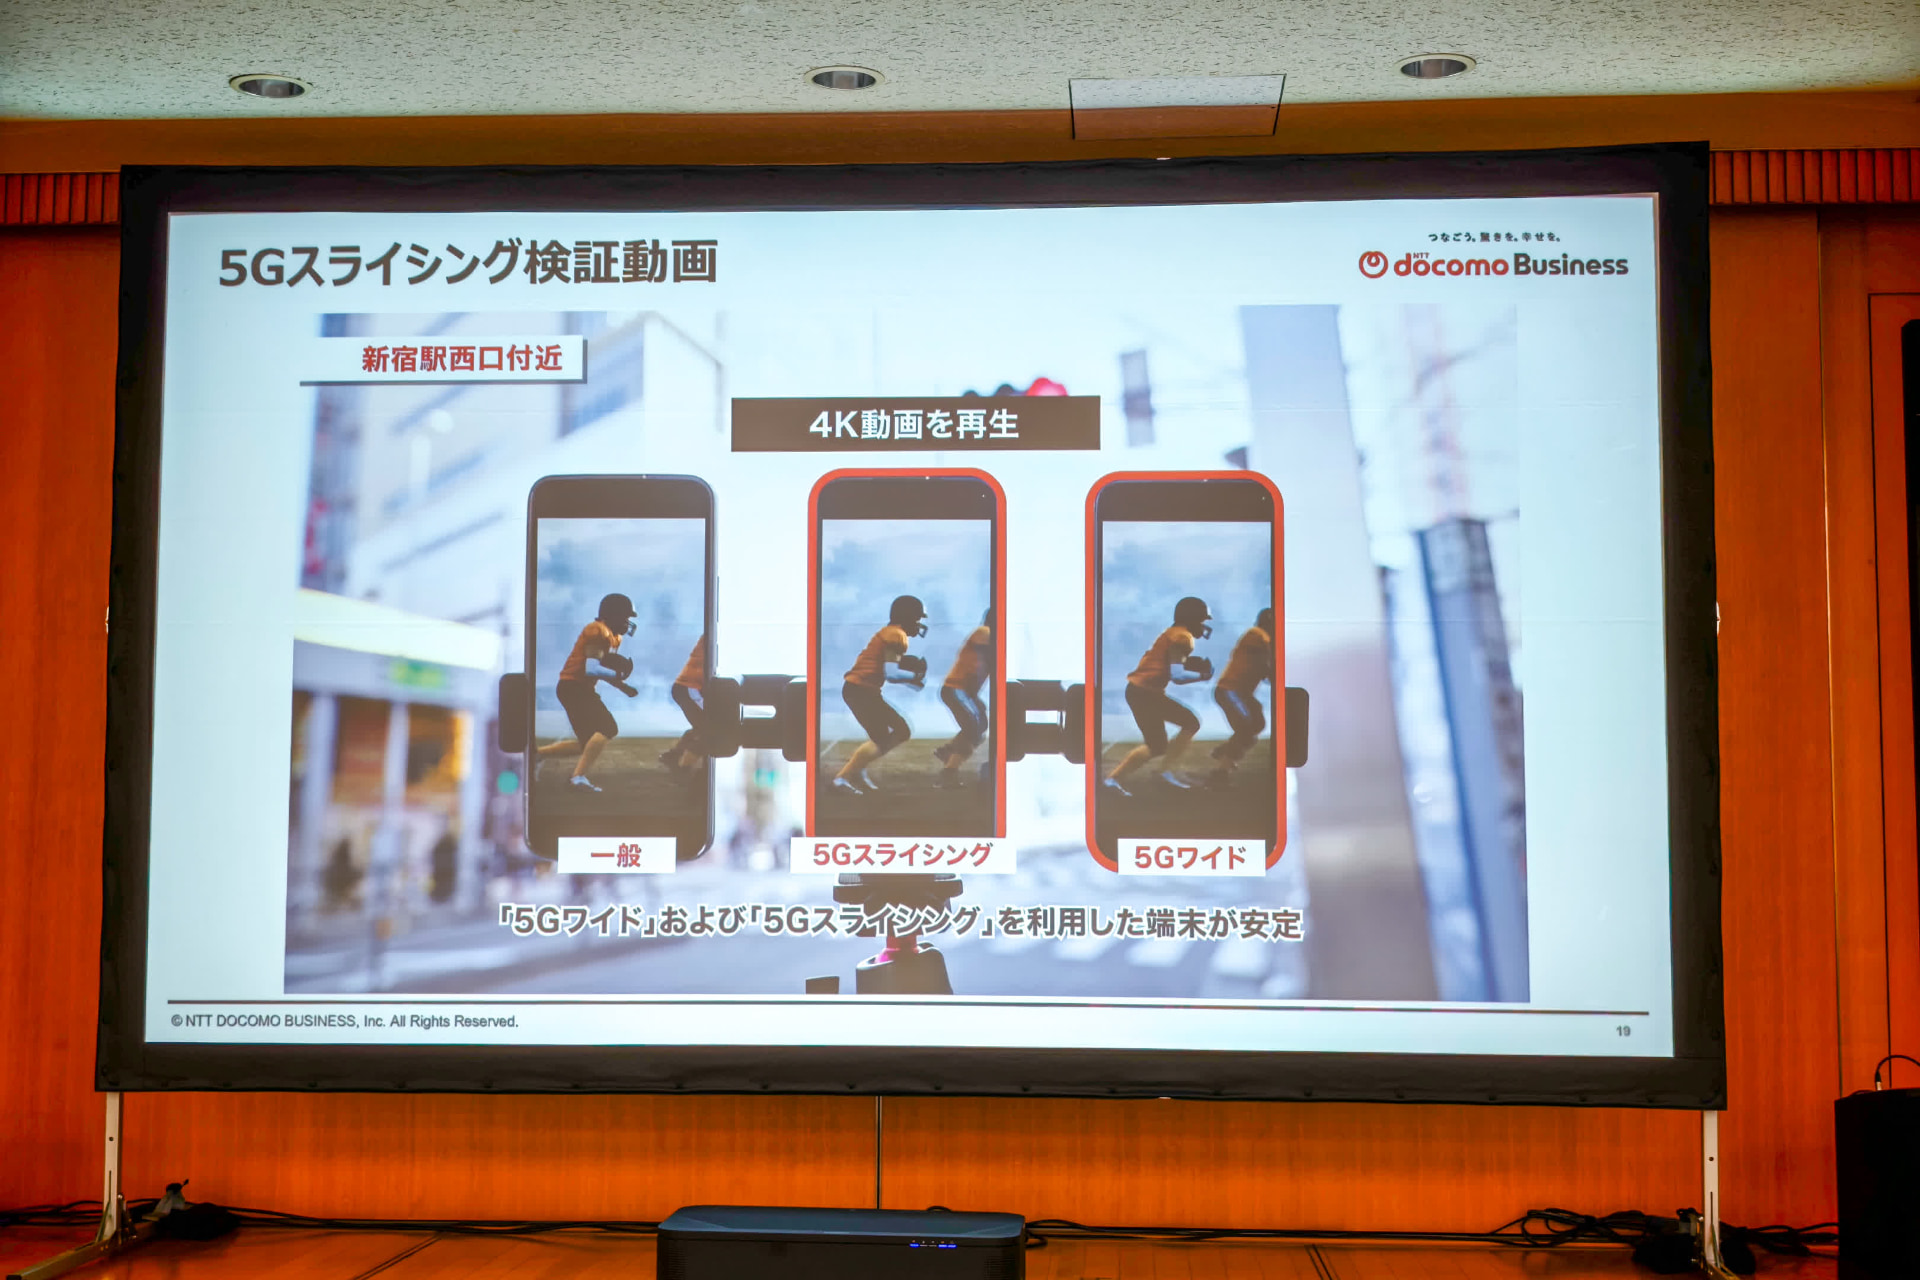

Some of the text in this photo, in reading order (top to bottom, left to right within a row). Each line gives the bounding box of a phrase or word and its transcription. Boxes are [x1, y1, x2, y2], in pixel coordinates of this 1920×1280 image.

[219, 238, 718, 288] 5Gスライシング検証動画
[1393, 252, 1629, 277] docomo Business
[362, 344, 563, 373] 新宿駅西口付近
[809, 408, 1020, 440] 4K動画を再生
[590, 843, 642, 868] 一般
[813, 842, 993, 867] 5Gスライシング
[1135, 845, 1246, 871] 5Gワイド
[500, 905, 1303, 939] 「5Gワイド」および「5Gスライシング」を利用した端末が安定
[186, 1014, 213, 1027] NTT
[216, 1014, 281, 1027] DOCOMO
[284, 1014, 360, 1028] BUSINESS,
[364, 1015, 386, 1028] Inc.
[390, 1015, 406, 1028] All
[410, 1015, 451, 1030] Rights
[454, 1015, 519, 1028] Reserved.
[1616, 1025, 1631, 1037] 19
